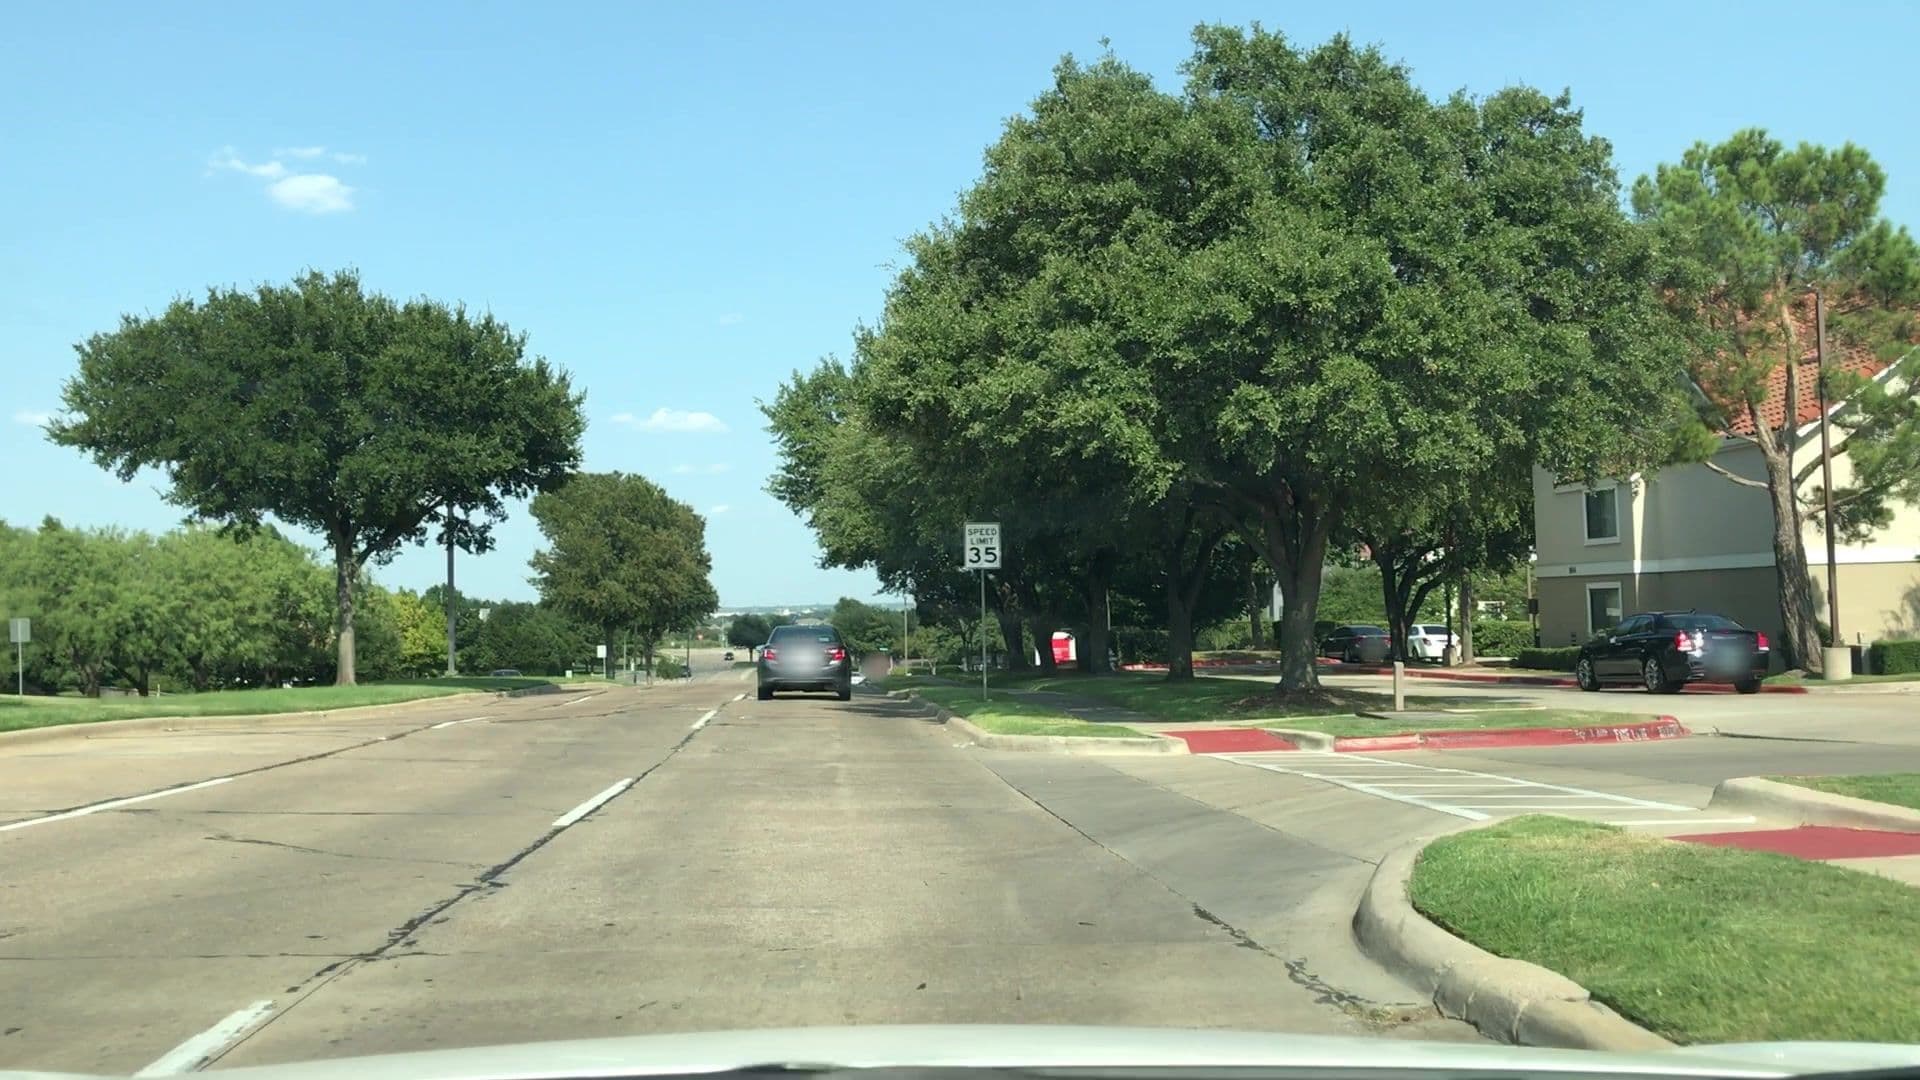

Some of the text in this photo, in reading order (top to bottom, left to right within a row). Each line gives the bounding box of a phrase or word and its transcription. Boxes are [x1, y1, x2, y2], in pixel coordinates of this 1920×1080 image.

[968, 528, 997, 536] SPEED
[970, 537, 994, 545] LIMIT
[969, 547, 997, 563] 35
